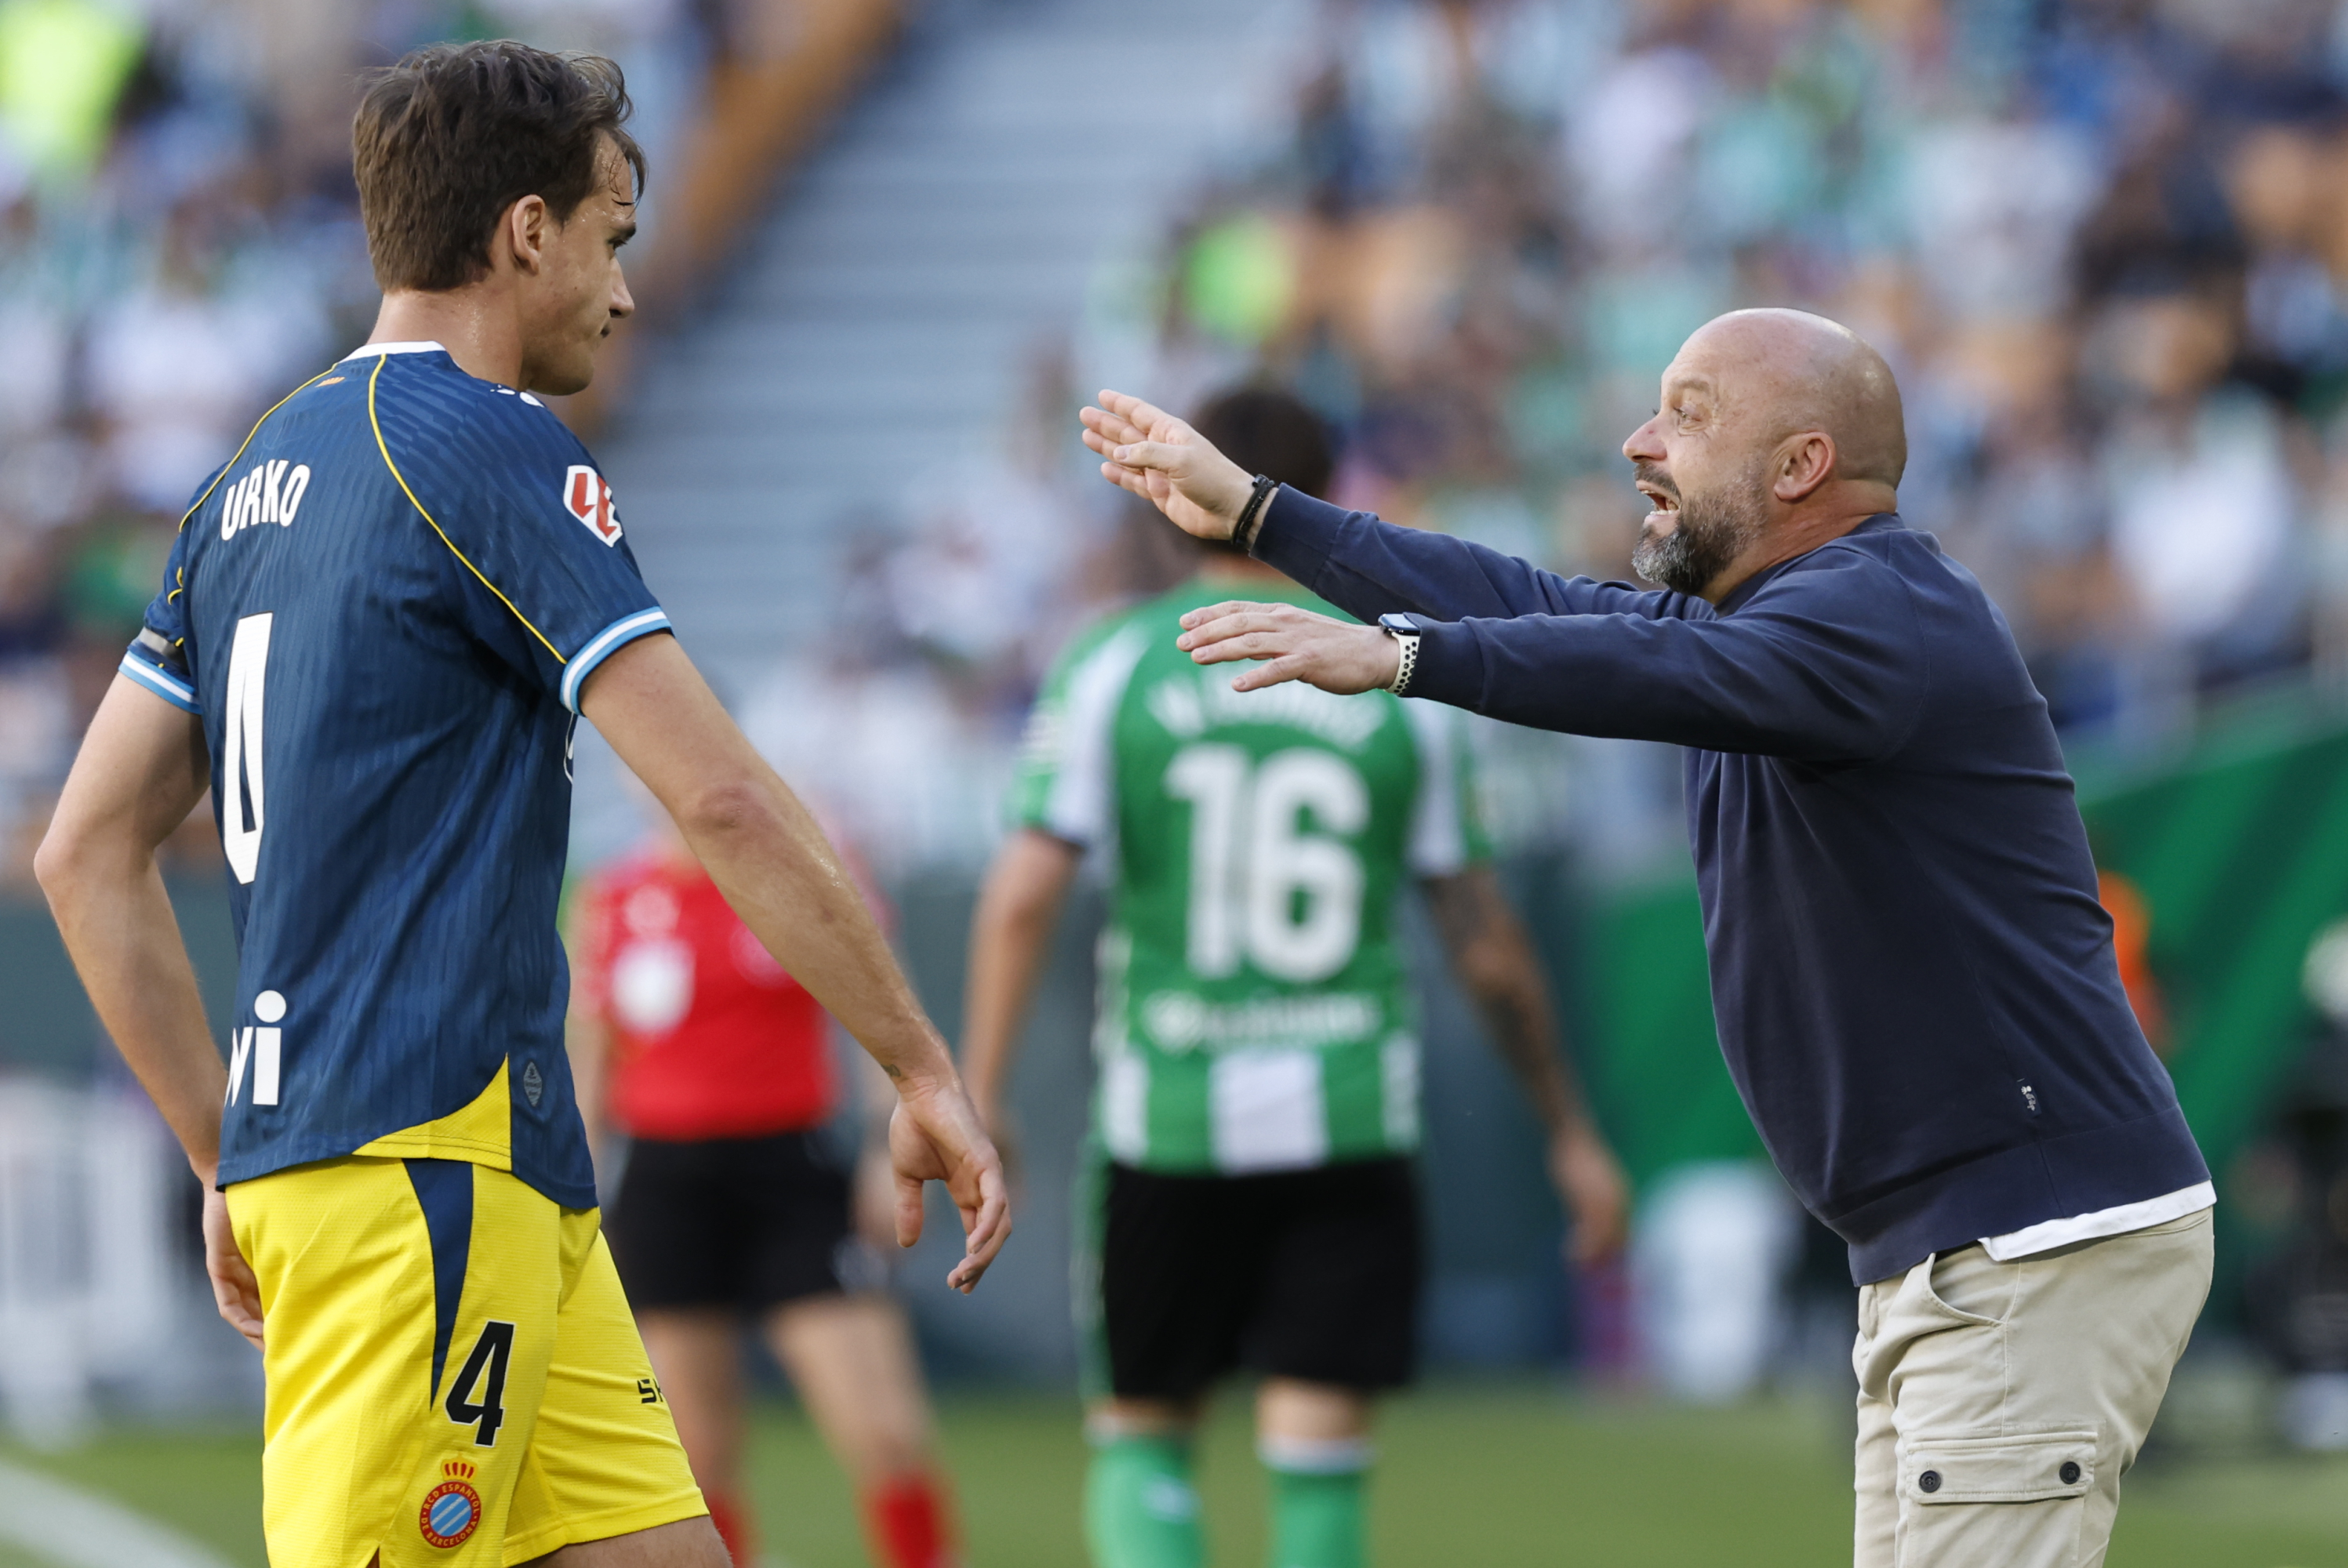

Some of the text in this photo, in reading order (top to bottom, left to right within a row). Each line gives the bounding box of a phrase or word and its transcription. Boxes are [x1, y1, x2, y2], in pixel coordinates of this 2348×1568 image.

[221, 459, 311, 541] URKO
[1165, 737, 1372, 985] 16
[444, 1319, 516, 1449] 4
[420, 1517, 478, 1547] DE BARCELONA
[423, 1483, 480, 1514] RCD ESPANYOL
